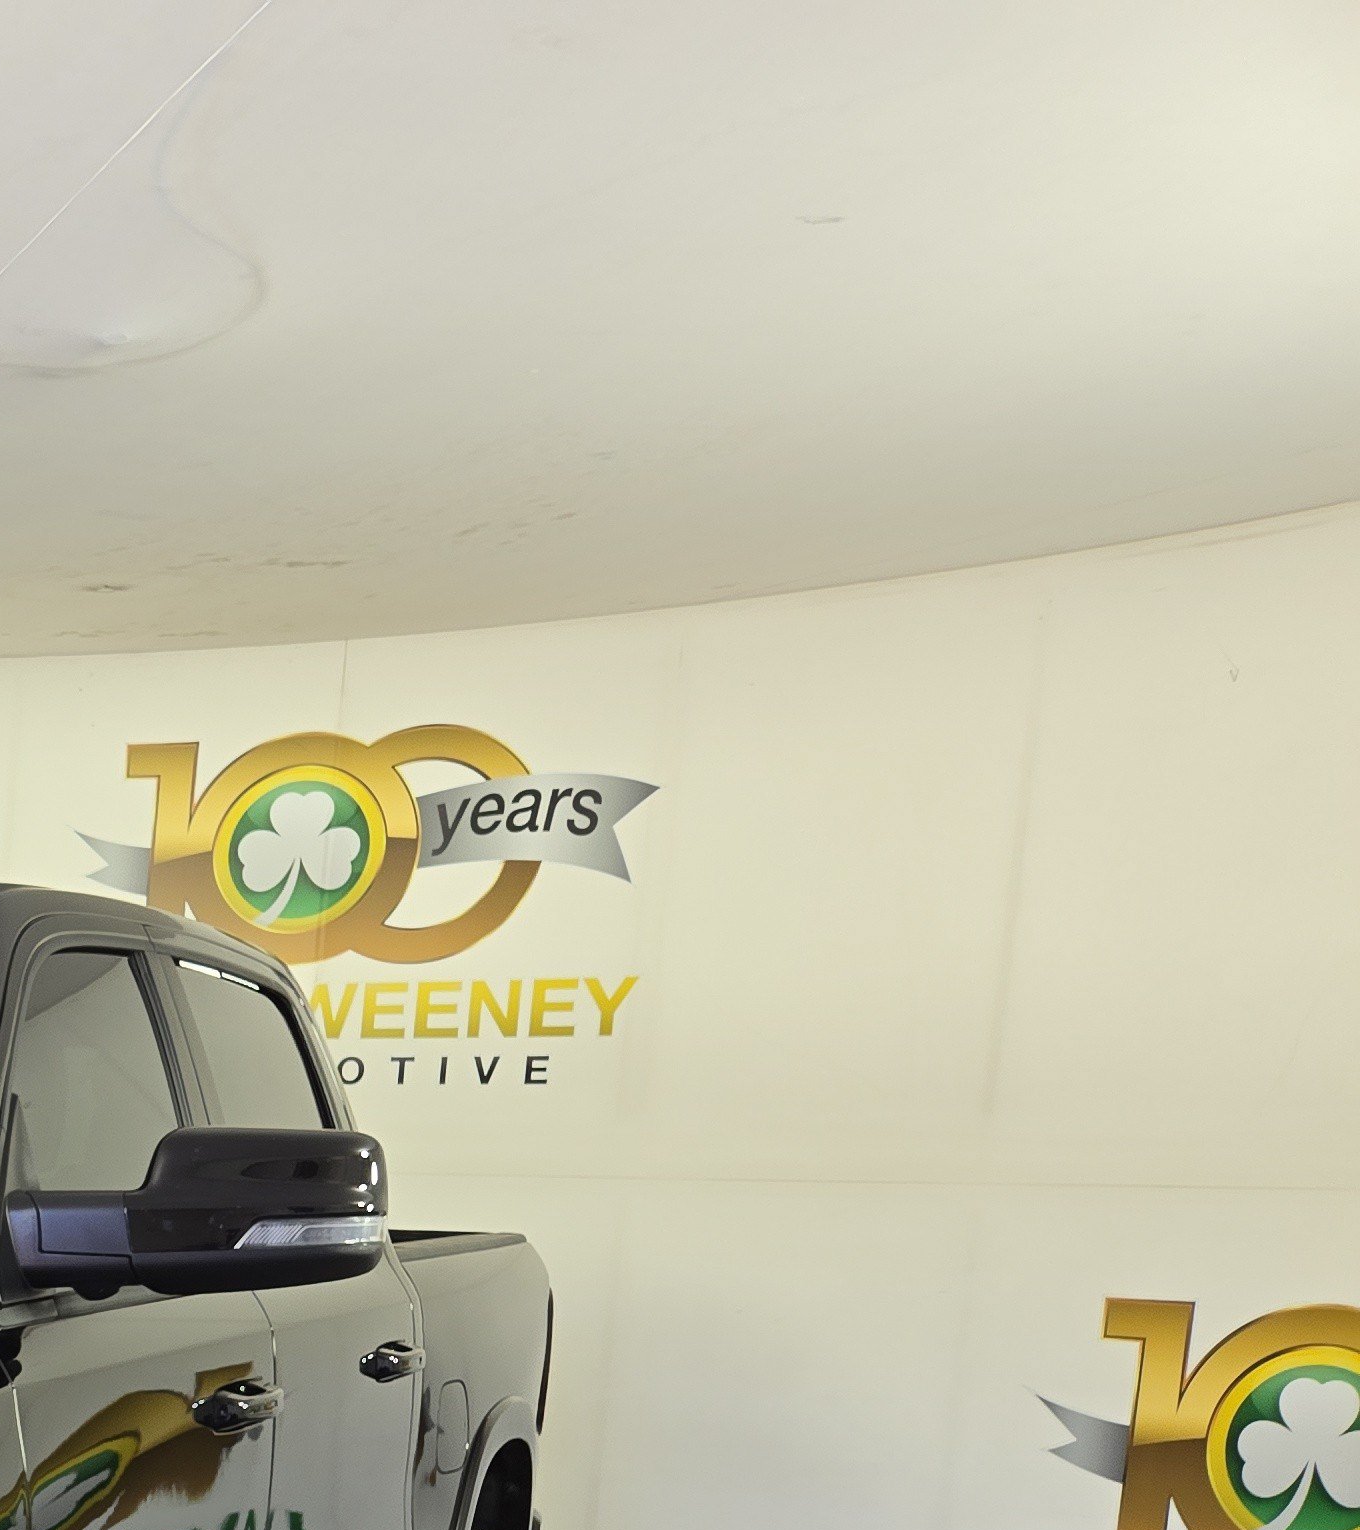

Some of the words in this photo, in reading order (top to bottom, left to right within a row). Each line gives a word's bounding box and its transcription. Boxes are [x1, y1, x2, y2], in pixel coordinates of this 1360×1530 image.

[126, 723, 542, 964] 100
[431, 783, 603, 857] years
[309, 976, 639, 1039] WEENEY
[337, 1055, 550, 1085] OTIVE
